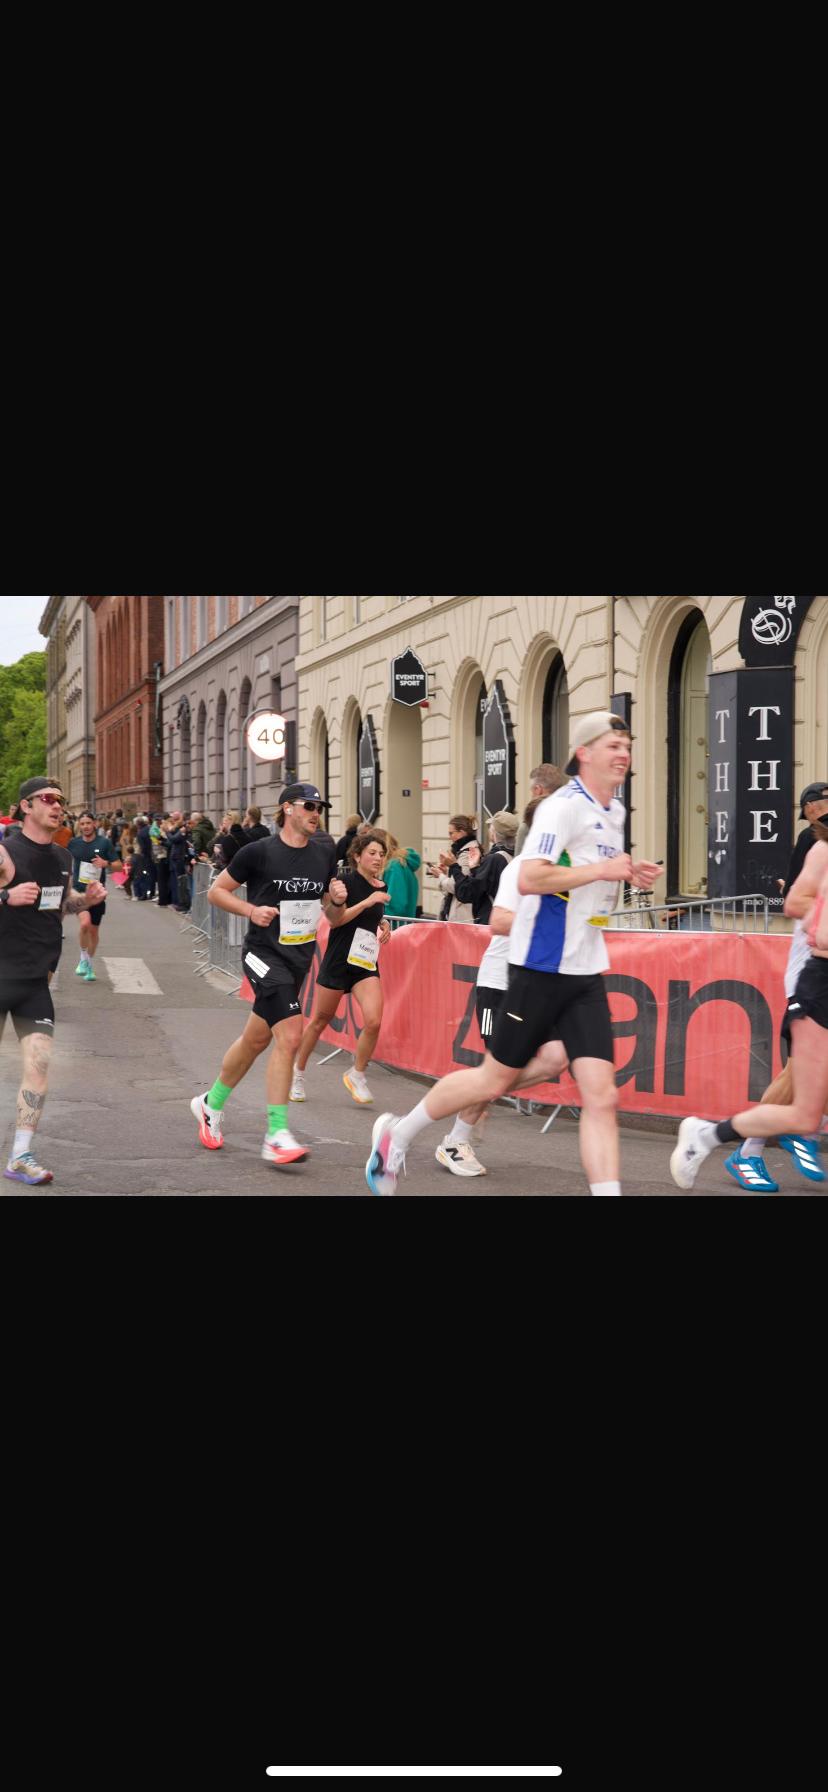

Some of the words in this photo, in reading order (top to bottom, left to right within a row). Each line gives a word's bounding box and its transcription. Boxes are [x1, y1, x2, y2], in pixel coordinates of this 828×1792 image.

[257, 728, 285, 745] 40
[485, 749, 506, 762] EVENTYR
[487, 763, 503, 775] SPORT
[715, 709, 730, 843] THE
[748, 706, 781, 843] THE
[43, 890, 62, 898] Martin
